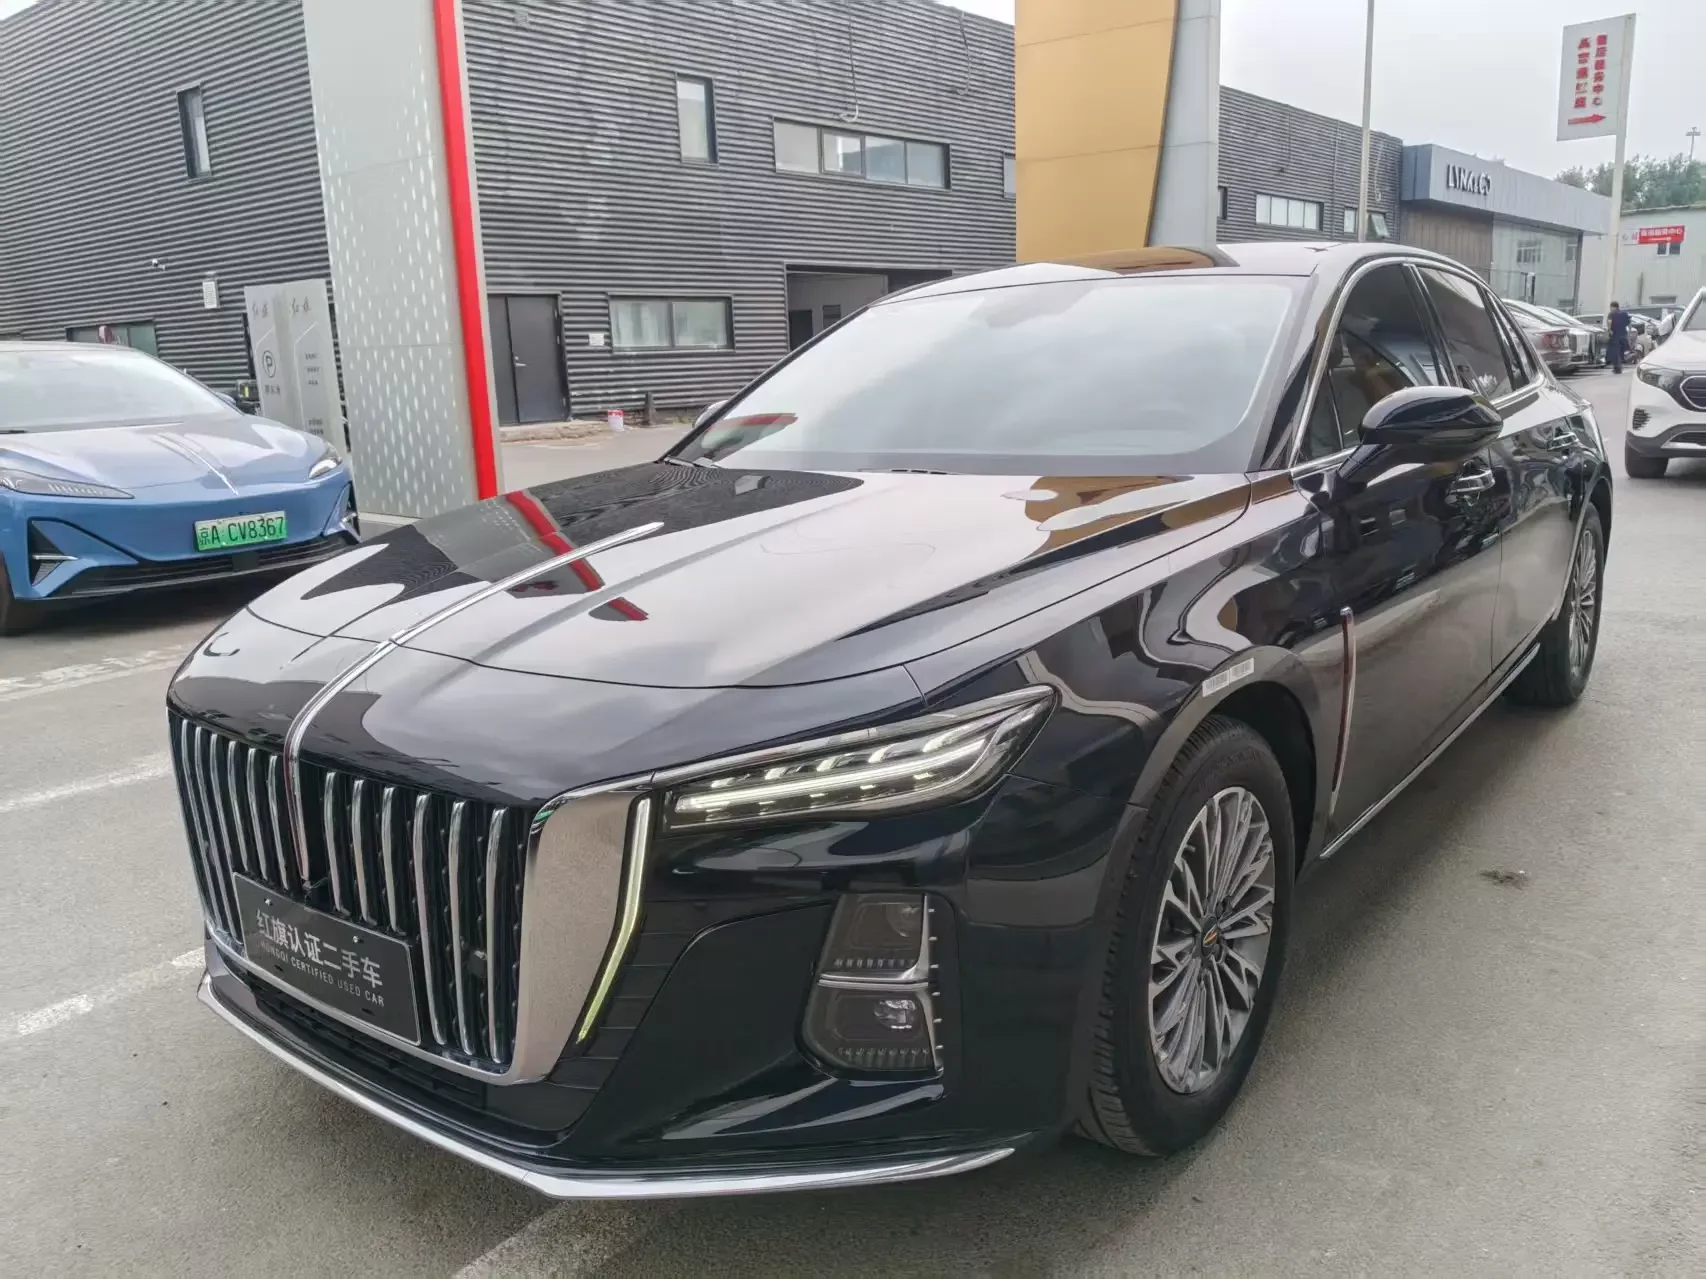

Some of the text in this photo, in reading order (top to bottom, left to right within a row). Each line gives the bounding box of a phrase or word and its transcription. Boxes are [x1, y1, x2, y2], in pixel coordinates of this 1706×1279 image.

[256, 908, 383, 989] 红旗认证二手车
[291, 956, 334, 985] CERTIFIED
[337, 979, 361, 997] USED
[364, 992, 385, 1007] CAR
